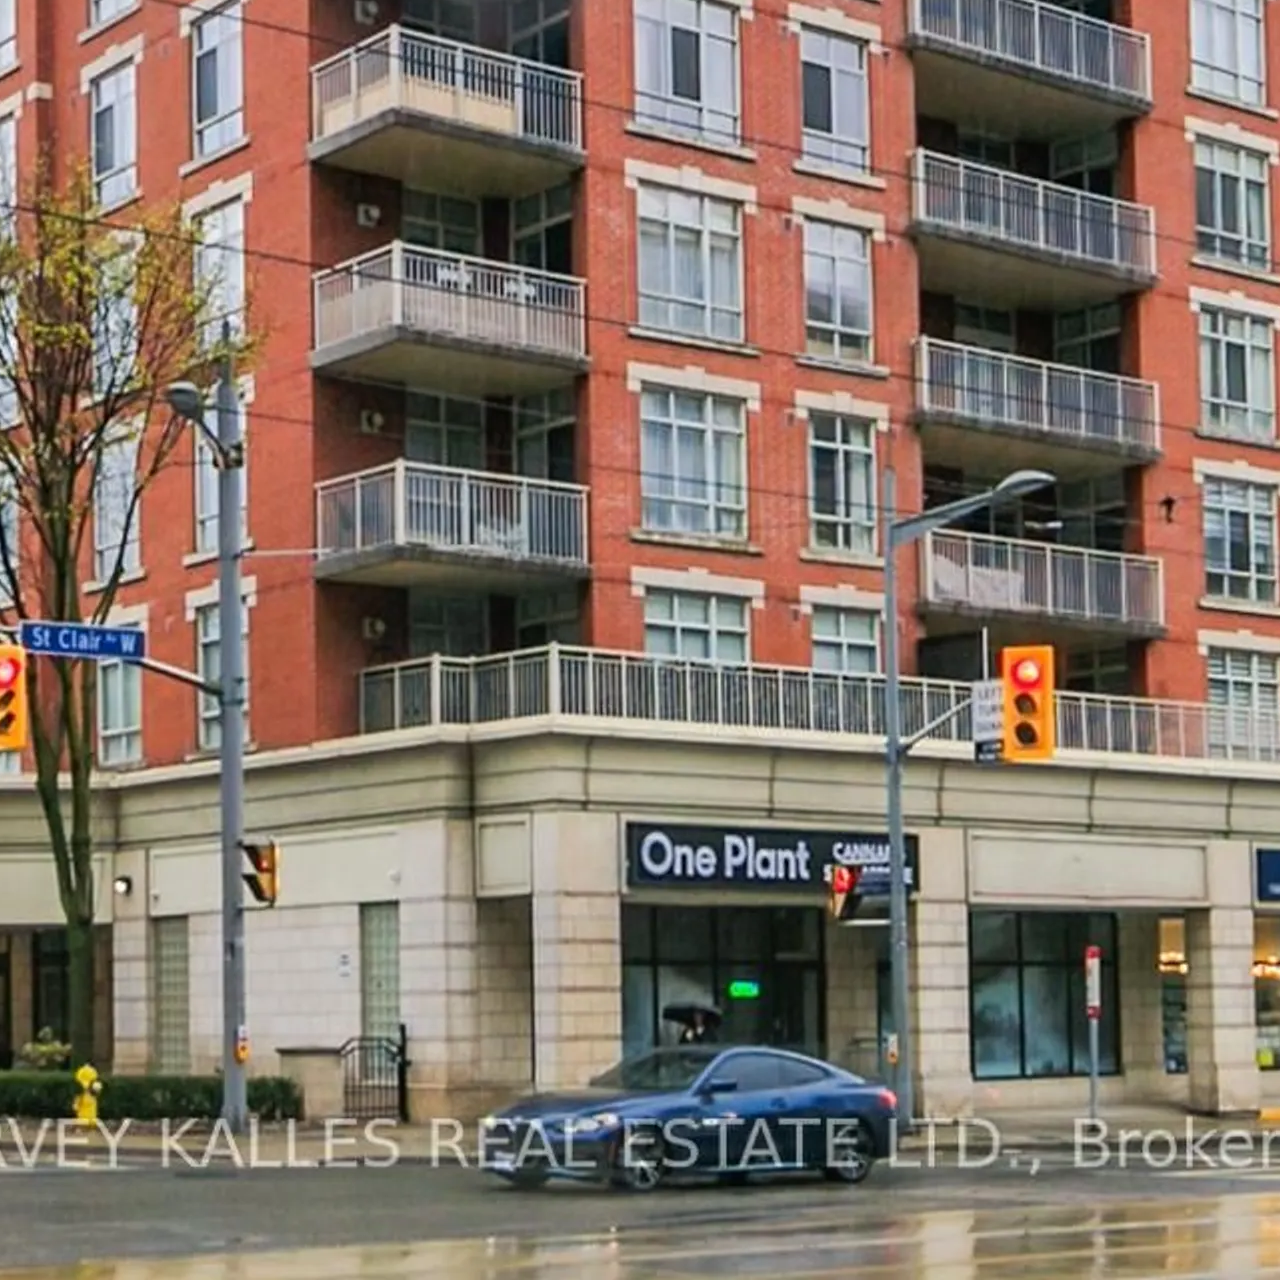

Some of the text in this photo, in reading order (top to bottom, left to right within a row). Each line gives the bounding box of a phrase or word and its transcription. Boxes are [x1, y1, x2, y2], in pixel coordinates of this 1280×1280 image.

[31, 626, 51, 648] St
[57, 628, 101, 651] Clair
[120, 633, 137, 654] W
[640, 831, 717, 877] One
[723, 834, 811, 880] Plant
[832, 842, 891, 865] CANNA
